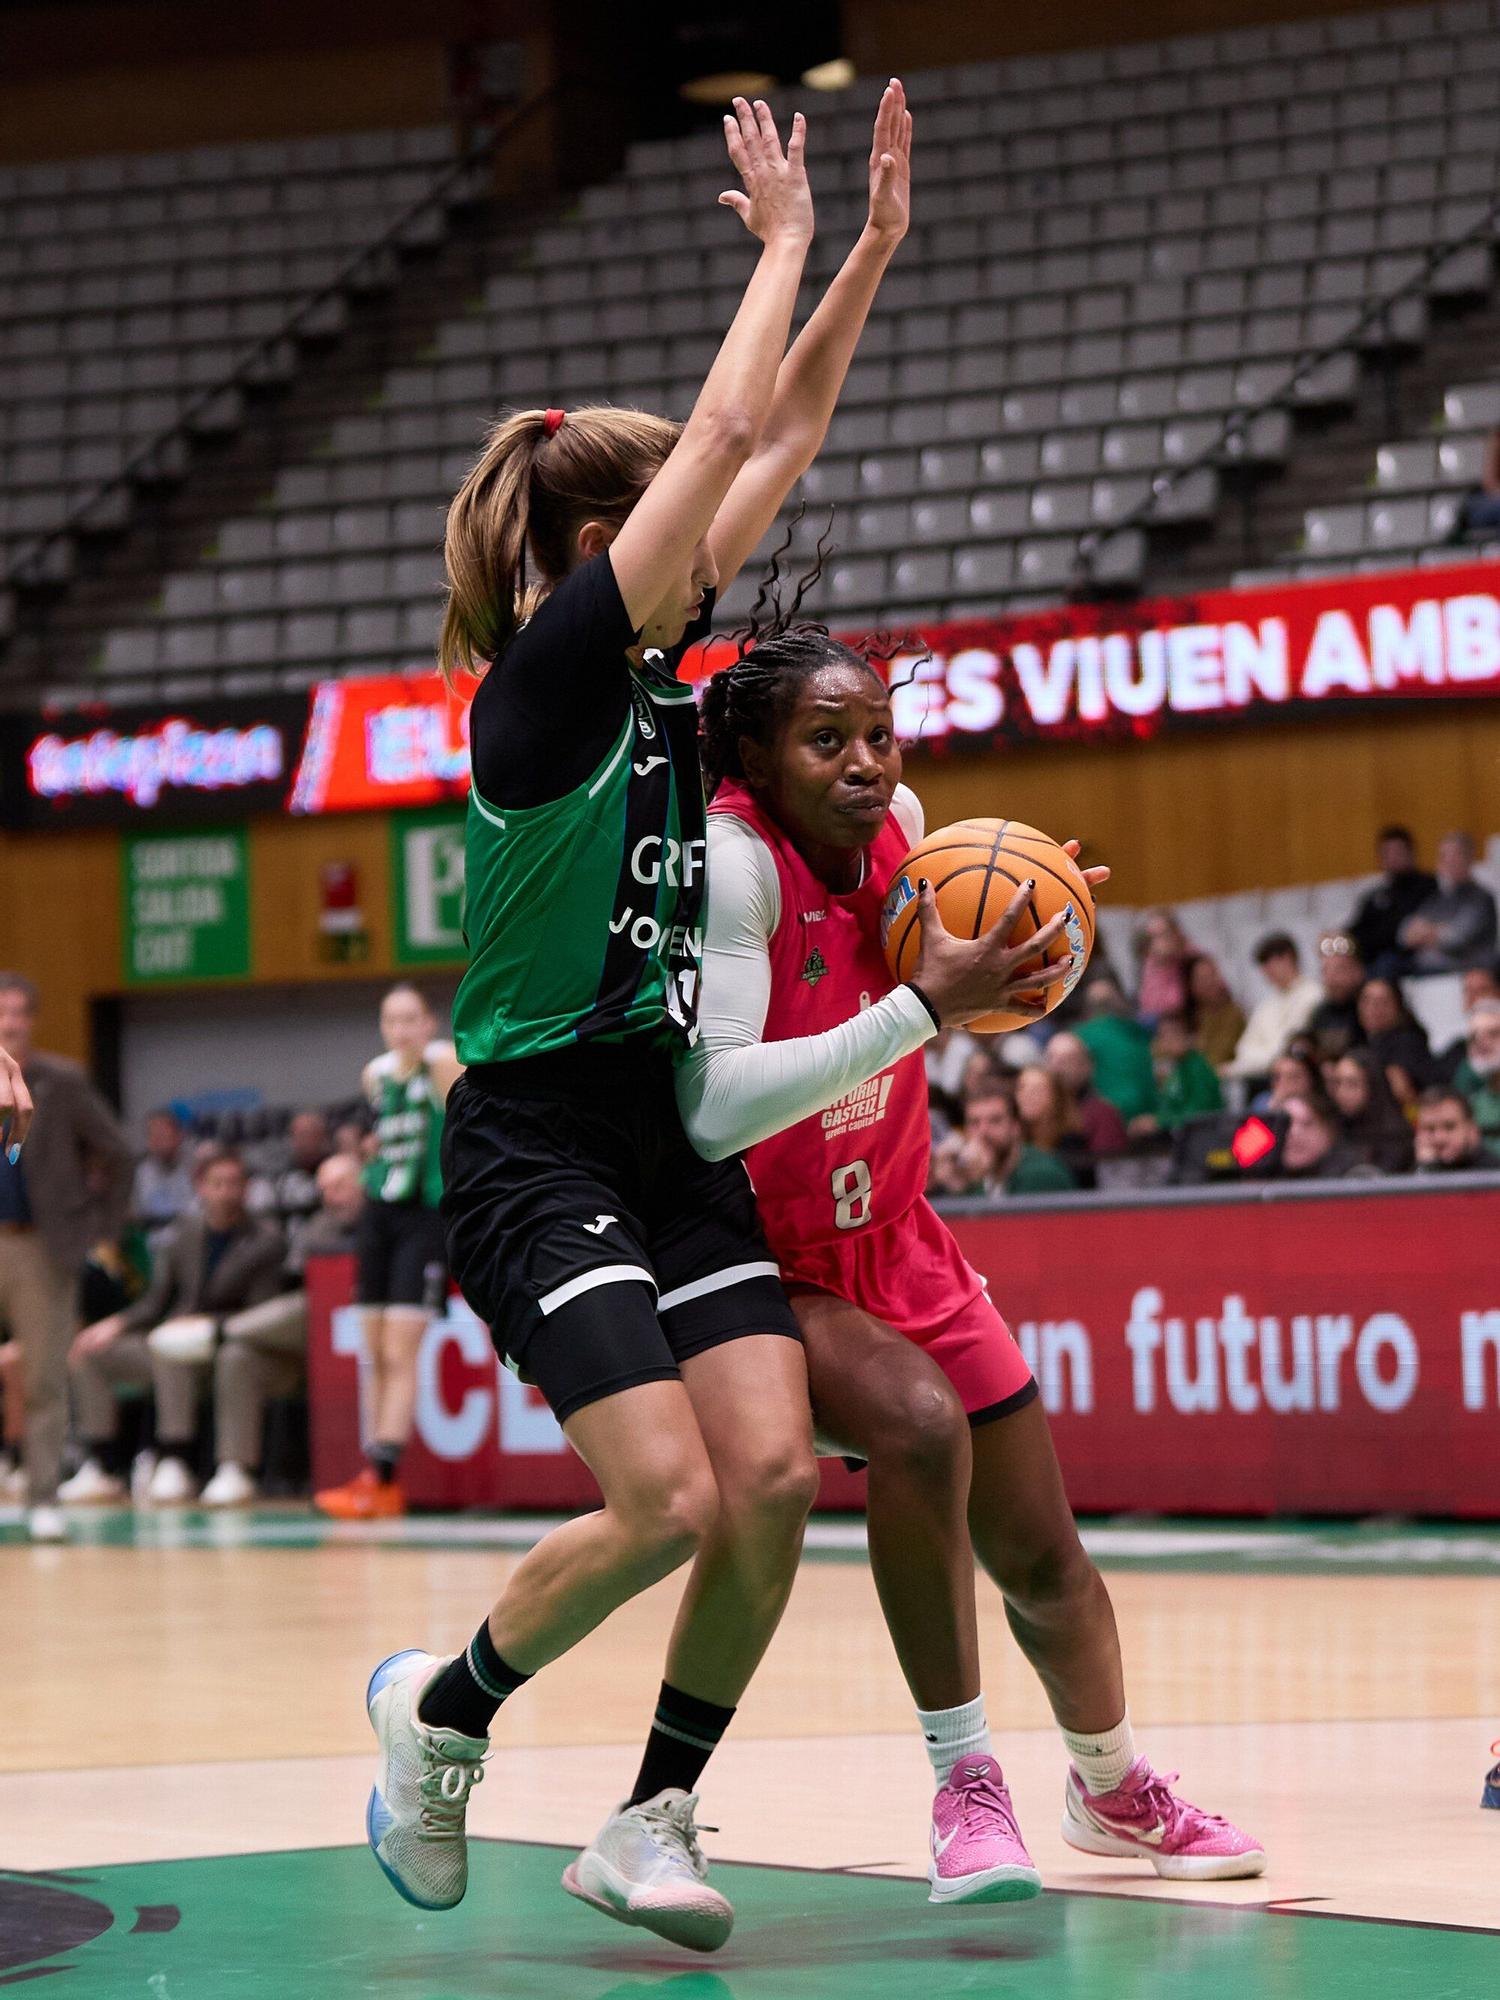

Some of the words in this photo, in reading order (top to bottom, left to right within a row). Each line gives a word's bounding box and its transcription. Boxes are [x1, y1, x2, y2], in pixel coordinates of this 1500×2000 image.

[1013, 616, 1290, 725] VIUEN
[1301, 594, 1500, 698] AMB
[365, 703, 472, 786] EL
[829, 1077, 880, 1110] ORIA
[831, 1159, 872, 1230] 8
[1125, 1285, 1419, 1415] futuro
